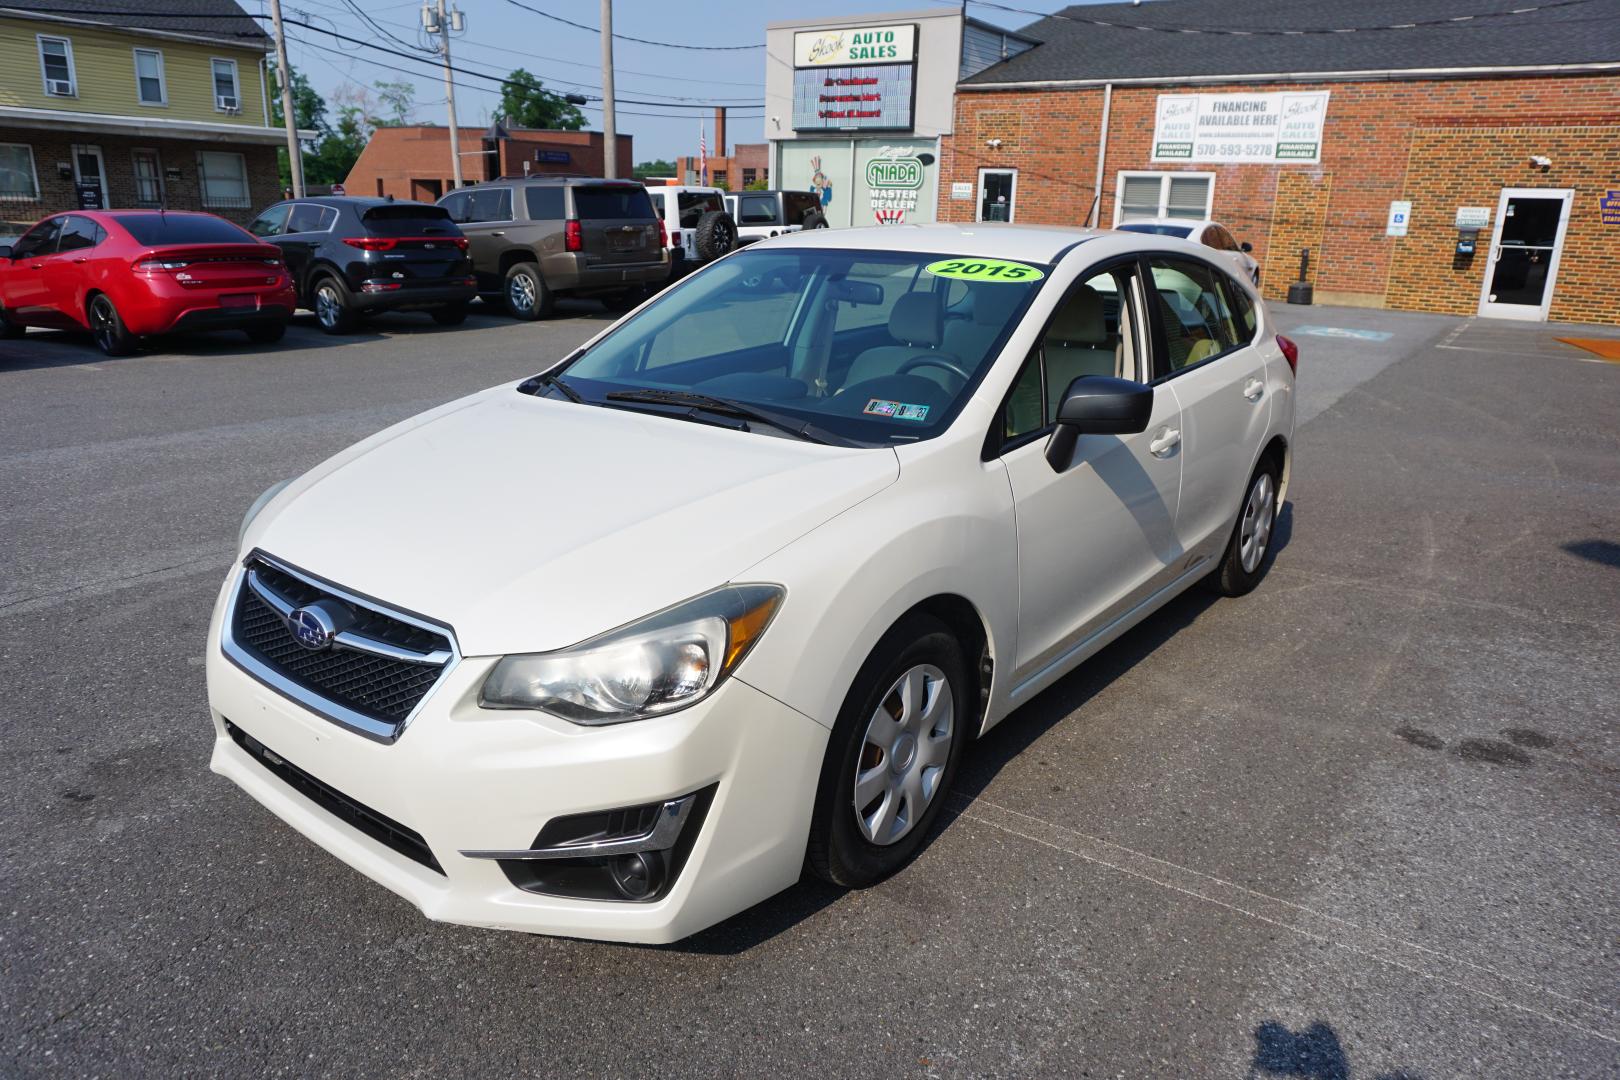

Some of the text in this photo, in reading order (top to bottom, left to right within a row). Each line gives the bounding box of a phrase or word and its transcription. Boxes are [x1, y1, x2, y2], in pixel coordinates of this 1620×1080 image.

[852, 31, 895, 45] AUTO
[849, 45, 897, 60] SALES
[1213, 101, 1267, 112] FINANCING
[1199, 114, 1279, 126] AVAILABLE HERE
[1197, 144, 1273, 156] 570-593-5278
[871, 165, 917, 181] NIADA
[870, 189, 917, 199] MASTER
[871, 199, 916, 209] DEALER
[936, 262, 1031, 278] 2015
